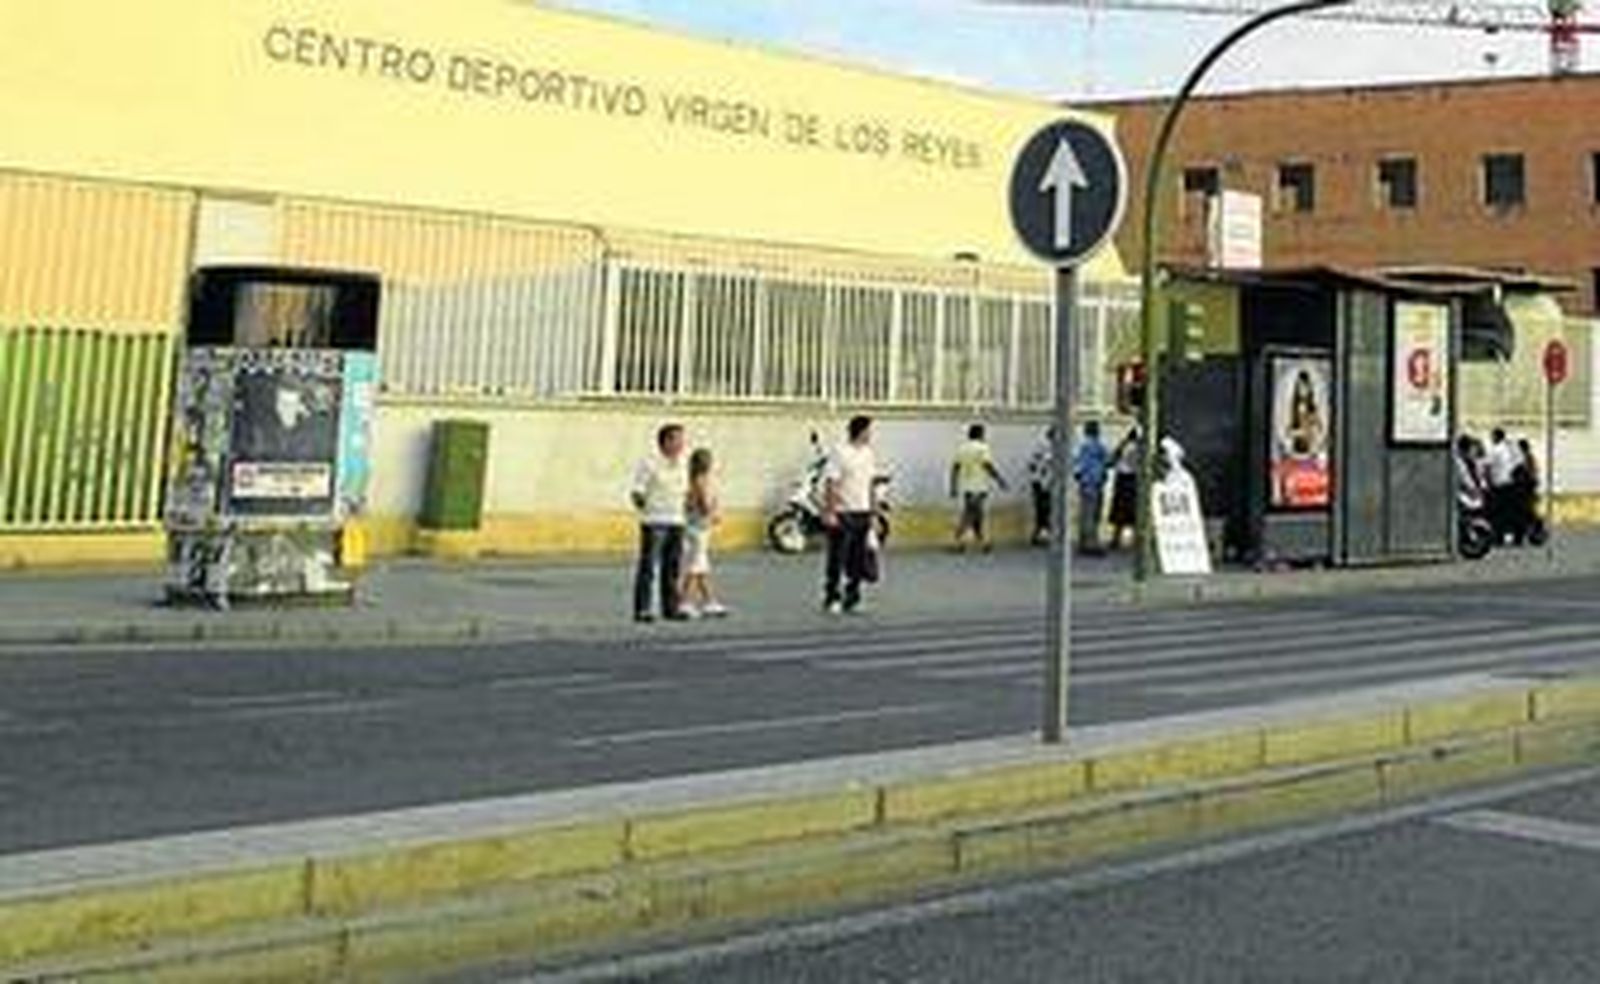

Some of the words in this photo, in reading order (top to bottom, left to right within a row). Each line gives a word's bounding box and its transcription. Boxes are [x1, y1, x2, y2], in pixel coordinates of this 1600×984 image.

[263, 26, 436, 84] CENTRO
[448, 55, 647, 117] DEPORTIVO
[661, 94, 770, 138] VIRGEN
[784, 112, 820, 147] DE
[835, 123, 890, 156] LOS
[901, 131, 983, 169] REYES
